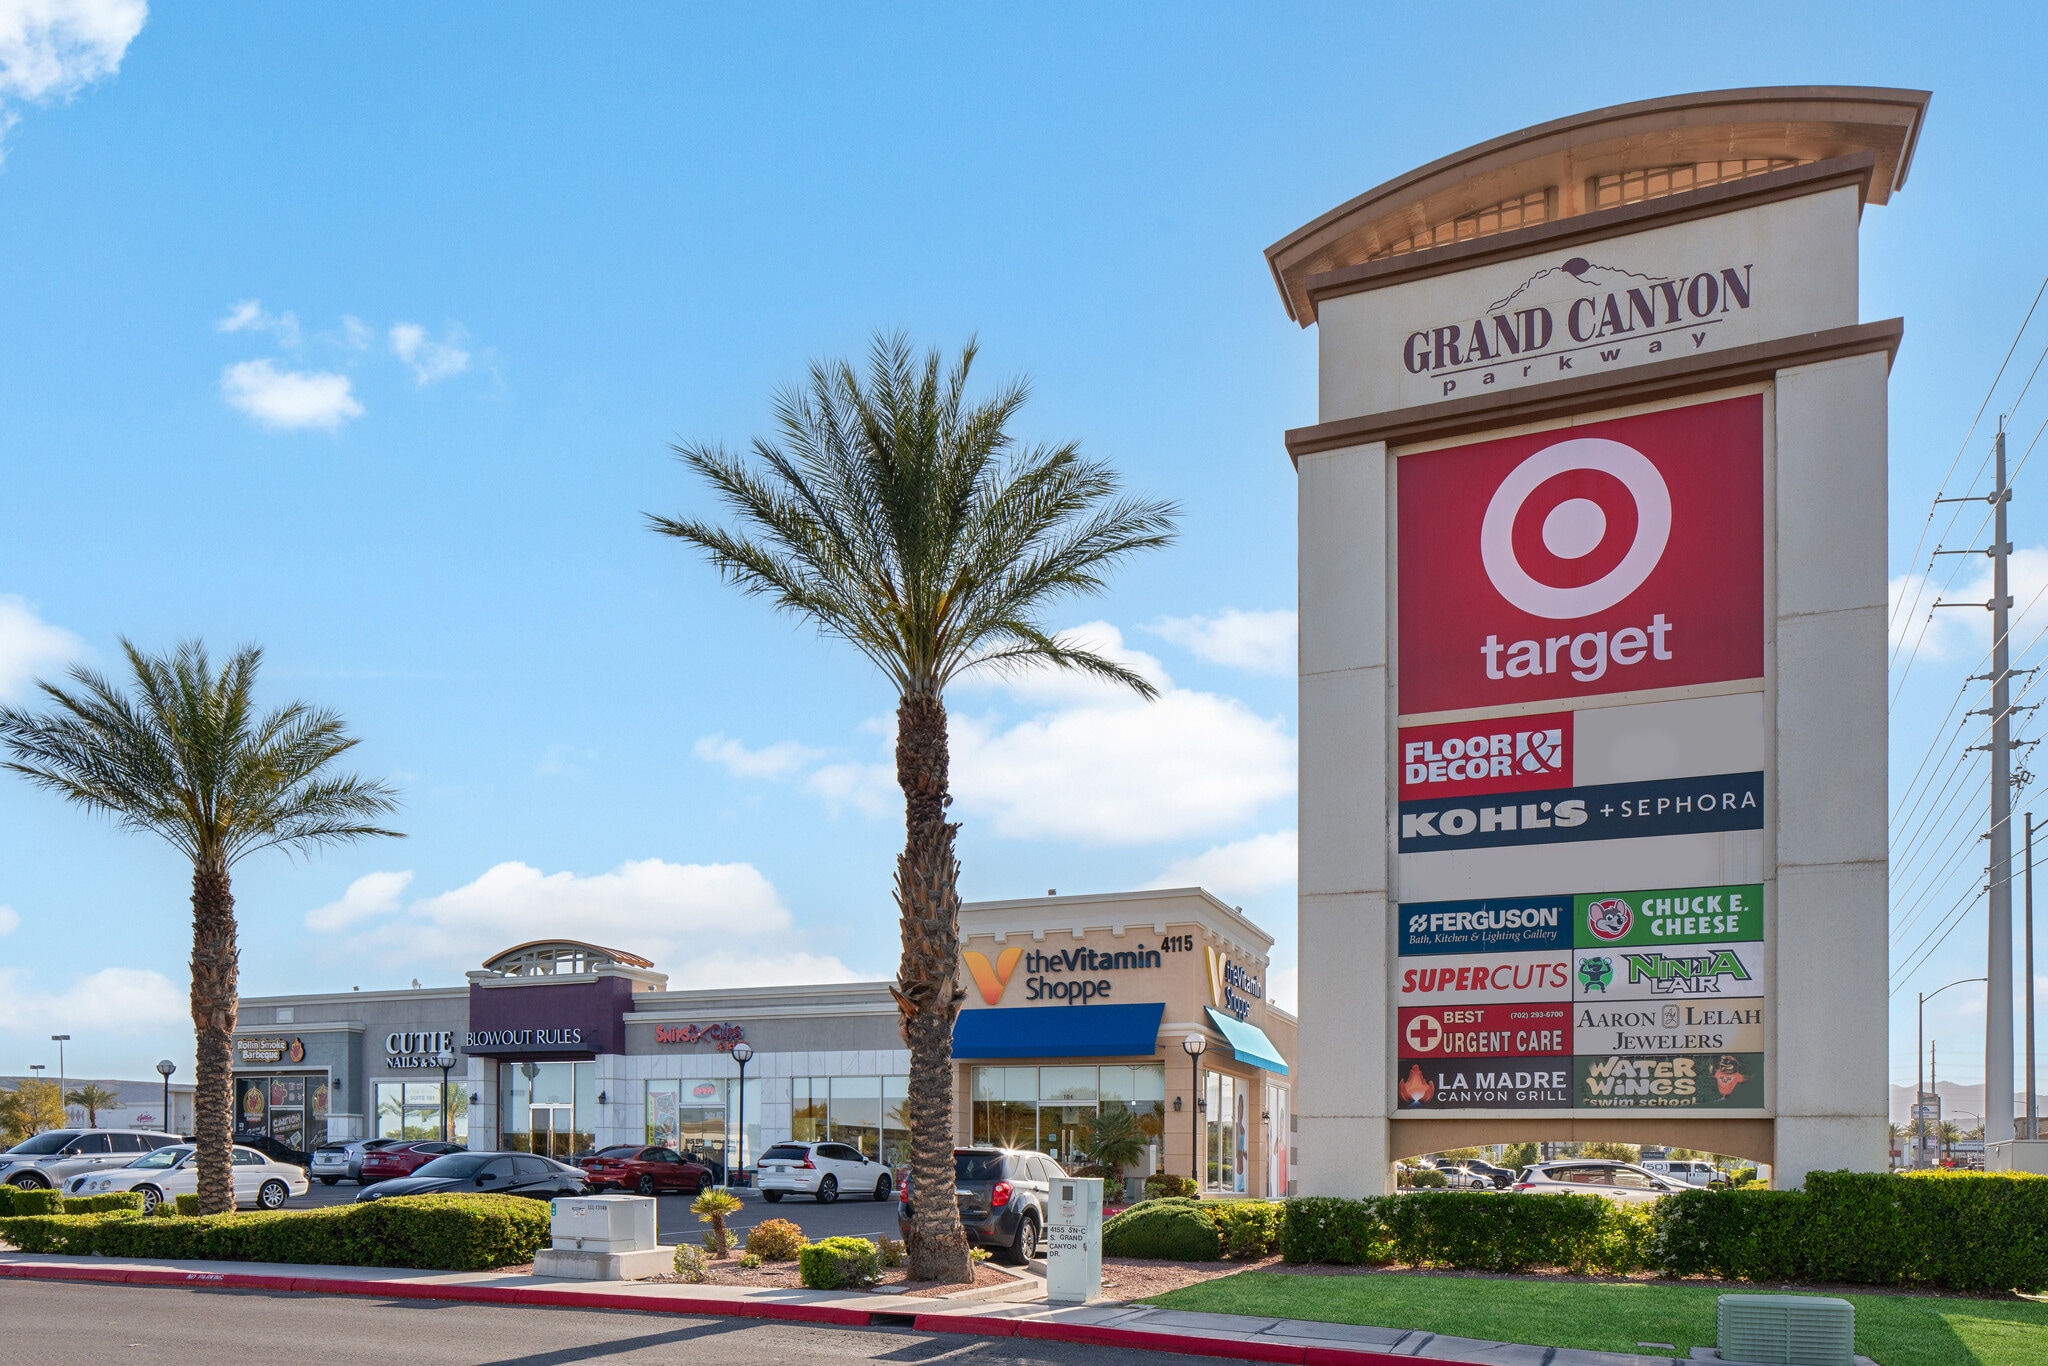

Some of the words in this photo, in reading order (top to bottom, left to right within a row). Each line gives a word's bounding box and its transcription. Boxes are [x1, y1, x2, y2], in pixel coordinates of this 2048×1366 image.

[1403, 307, 1553, 374] GRAND
[1568, 264, 1754, 342] CANYON
[1443, 331, 1706, 396] parkway
[1480, 614, 1673, 682] target
[1405, 734, 1512, 764] FLOOR
[1405, 756, 1512, 785] DECOR
[1402, 800, 1588, 838] KOHL'S
[1642, 896, 1722, 916] CHUCK
[1729, 894, 1749, 913] E.
[1430, 907, 1558, 932] FERGUSON
[1650, 915, 1739, 936] CHEESE
[1409, 934, 1431, 944] Bath,
[1435, 933, 1468, 943] Kitchen
[1471, 933, 1479, 942] &
[1482, 931, 1520, 944] Lighting
[1523, 929, 1557, 941] Gallery
[1025, 944, 1161, 973] theVitamin
[1161, 935, 1193, 952] 4115
[1402, 962, 1568, 993] SUPERCUTS
[1620, 950, 1752, 984] NINJA
[1026, 976, 1111, 1005] Shoppe
[1651, 976, 1721, 994] LAIR
[1225, 986, 1250, 1021] Shoppe
[1444, 1010, 1484, 1023] BEST
[1510, 1012, 1529, 1020] (702)
[1577, 1009, 1656, 1028] AARON
[1685, 1006, 1762, 1025] LELAH
[237, 1041, 259, 1049] Rollin
[260, 1040, 285, 1049] Smoke
[385, 1031, 453, 1055] CUTIE
[467, 1029, 532, 1046] BLOWOUT
[537, 1028, 581, 1044] RULES
[1443, 1031, 1511, 1053] URGENT
[1516, 1030, 1562, 1052] CARE
[1613, 1032, 1723, 1050] JEWELERS
[243, 1051, 279, 1061] Barbeque
[386, 1056, 418, 1068] NAILS
[420, 1059, 428, 1067] &
[1589, 1056, 1696, 1078] WATER
[693, 1086, 715, 1096] OPEN
[1438, 1073, 1468, 1089] LA
[1476, 1071, 1567, 1089] MADRE
[1438, 1091, 1507, 1101] CANYON
[1516, 1090, 1567, 1101] GRILL
[1590, 1097, 1634, 1106] swim
[1639, 1097, 1697, 1106] school
